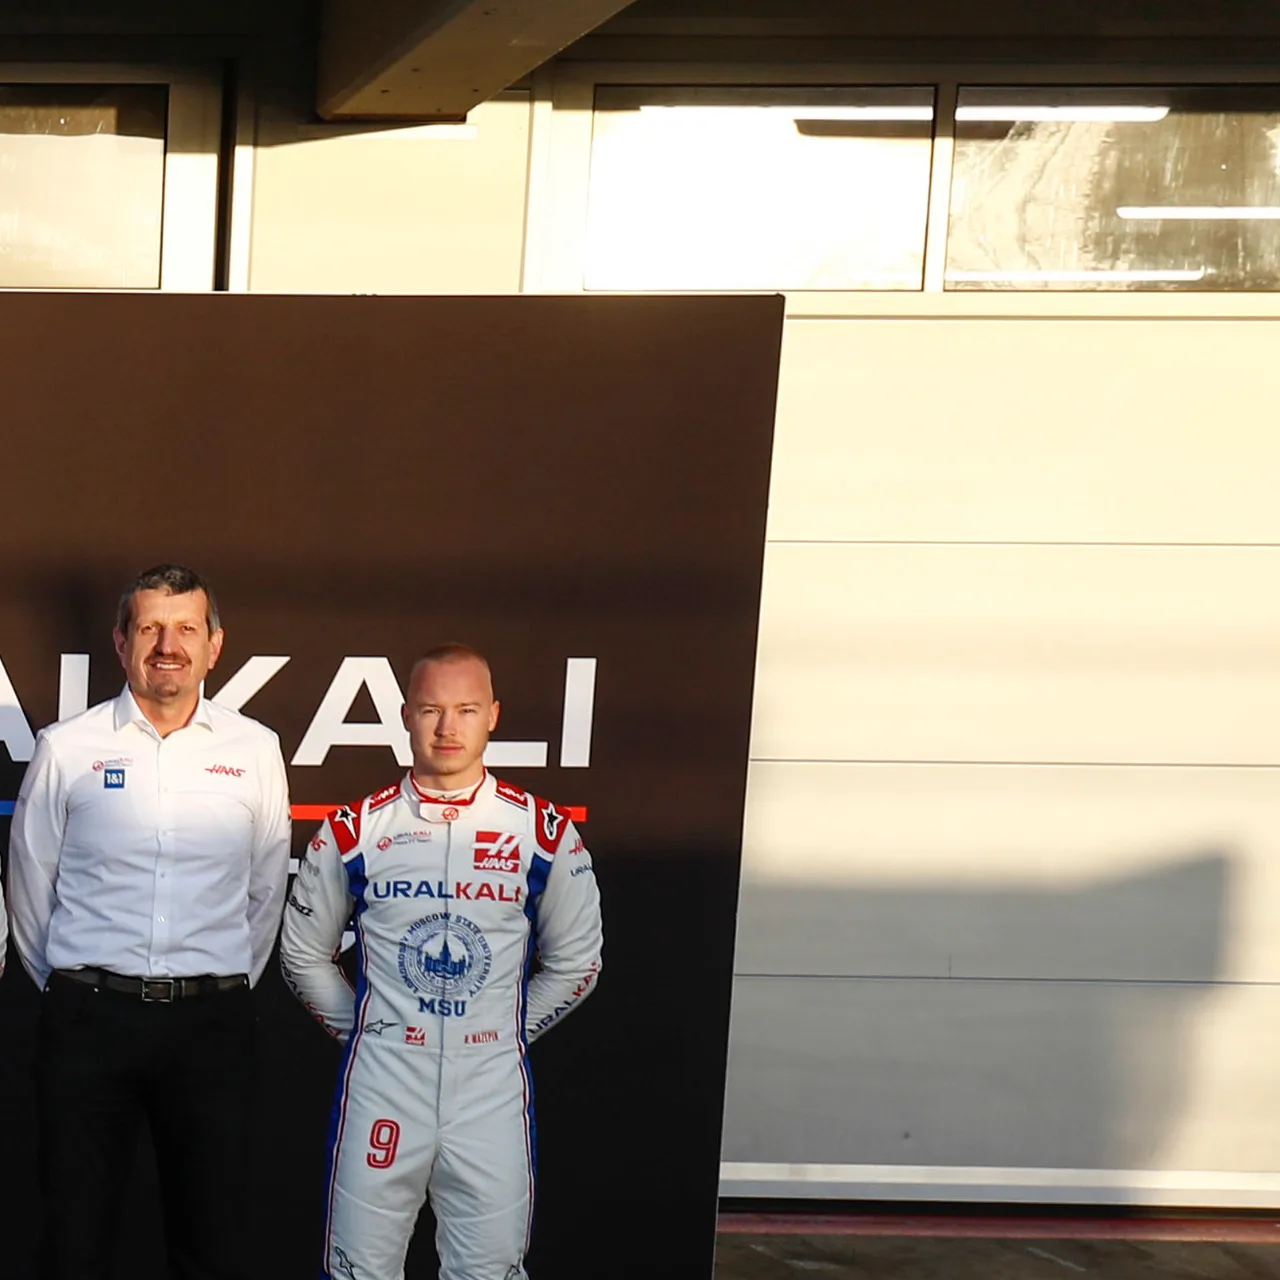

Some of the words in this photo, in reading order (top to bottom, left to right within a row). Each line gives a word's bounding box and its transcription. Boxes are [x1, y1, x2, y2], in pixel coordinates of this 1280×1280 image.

[204, 763, 247, 778] HAAS
[473, 857, 521, 870] HAAS
[372, 880, 520, 904] URALKALI
[418, 996, 467, 1018] MSU
[366, 1119, 401, 1170] 9
